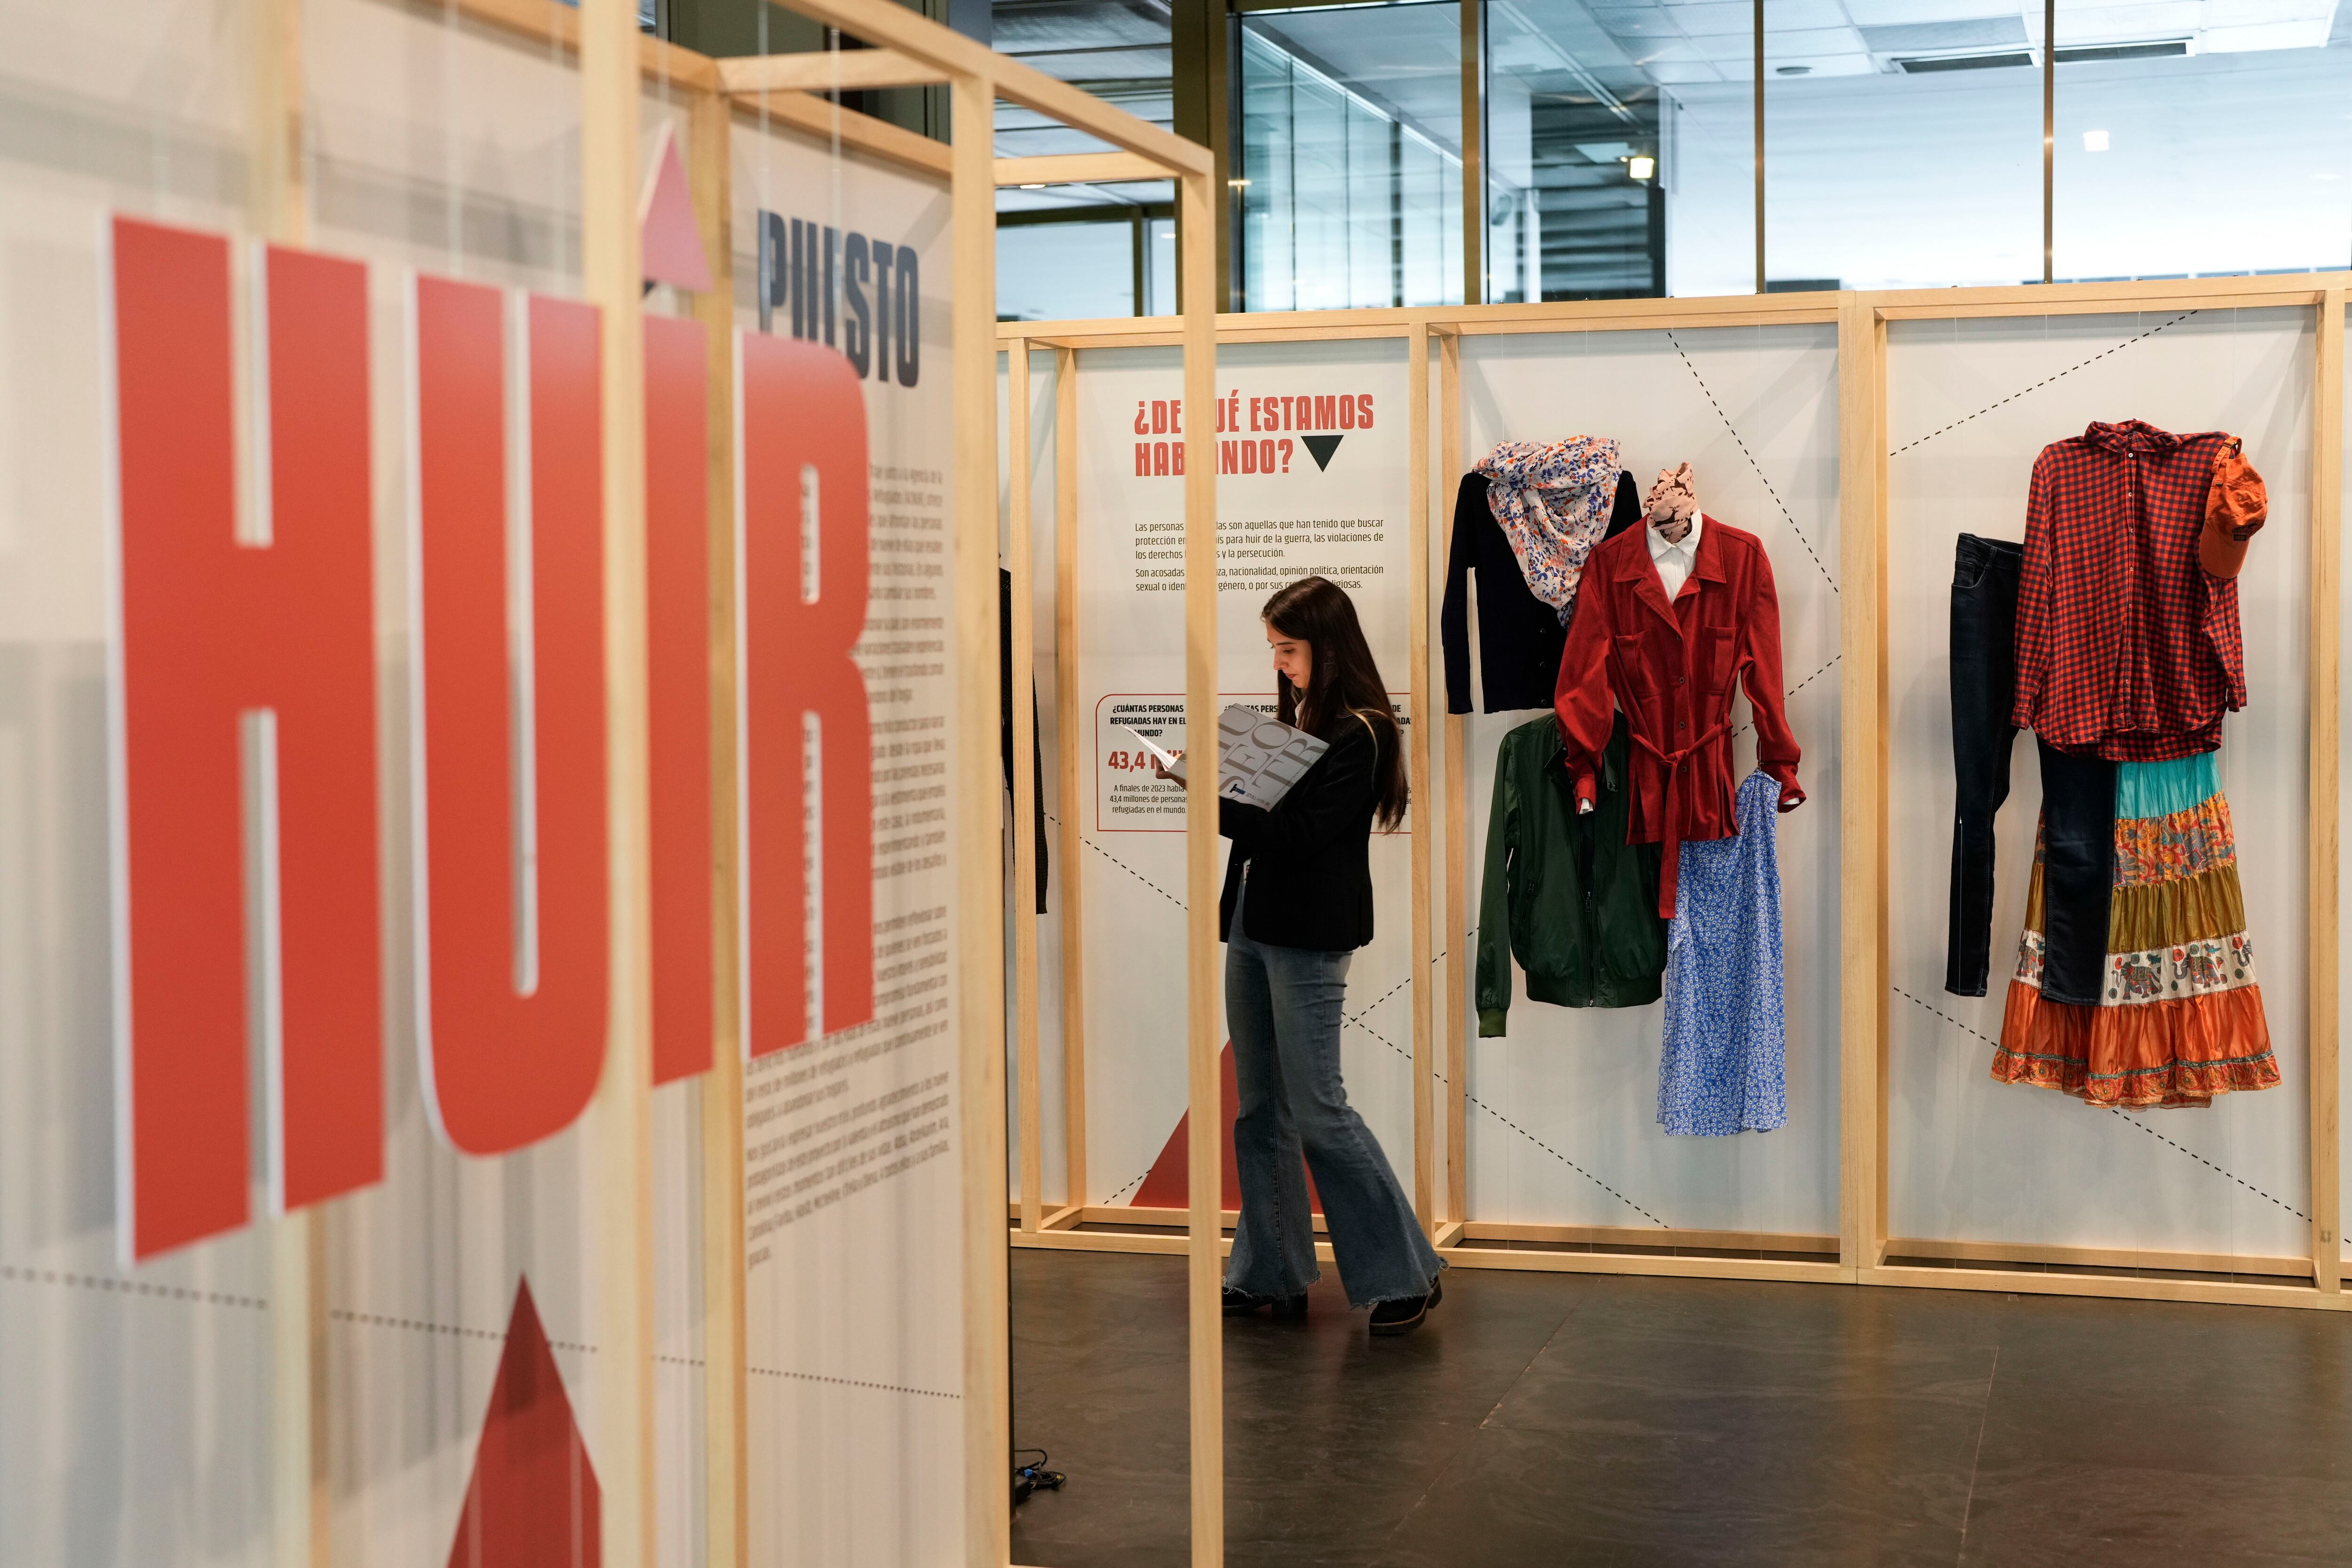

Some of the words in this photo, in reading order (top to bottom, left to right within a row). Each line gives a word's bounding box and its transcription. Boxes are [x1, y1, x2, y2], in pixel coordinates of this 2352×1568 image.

[1135, 400, 1181, 435] ¿DE
[1215, 390, 1239, 432] UÉ
[1250, 394, 1373, 431] ESTAMOS
[1135, 439, 1293, 476] HABNDO?
[1150, 524, 1184, 533] personas
[1245, 520, 1277, 531] aquellas
[1279, 521, 1294, 530] que
[1296, 520, 1311, 528] han
[1313, 519, 1338, 528] tenido
[1341, 520, 1355, 529] que
[1136, 536, 1175, 547] protección
[1226, 536, 1243, 545] para
[1246, 534, 1261, 543] huir
[1263, 534, 1272, 543] de
[1285, 535, 1311, 544] guerra,
[1314, 533, 1325, 542] las
[1327, 533, 1371, 542] violaciones
[1374, 533, 1383, 541] de
[1136, 550, 1146, 559] los
[1149, 550, 1183, 559] derechos
[1229, 549, 1234, 557] la
[1238, 549, 1285, 559] persecución.
[1151, 568, 1184, 577] acosadas
[1229, 566, 1278, 576] nacionalidad,
[1280, 566, 1307, 576] opinión
[1310, 565, 1339, 575] política,
[1341, 565, 1383, 574] orientación
[1136, 582, 1160, 591] sexual
[1218, 581, 1247, 591] género,
[1256, 582, 1268, 591] por
[1112, 704, 1147, 713] ¿CUÁNTAS
[1108, 751, 1145, 772] 43,4
